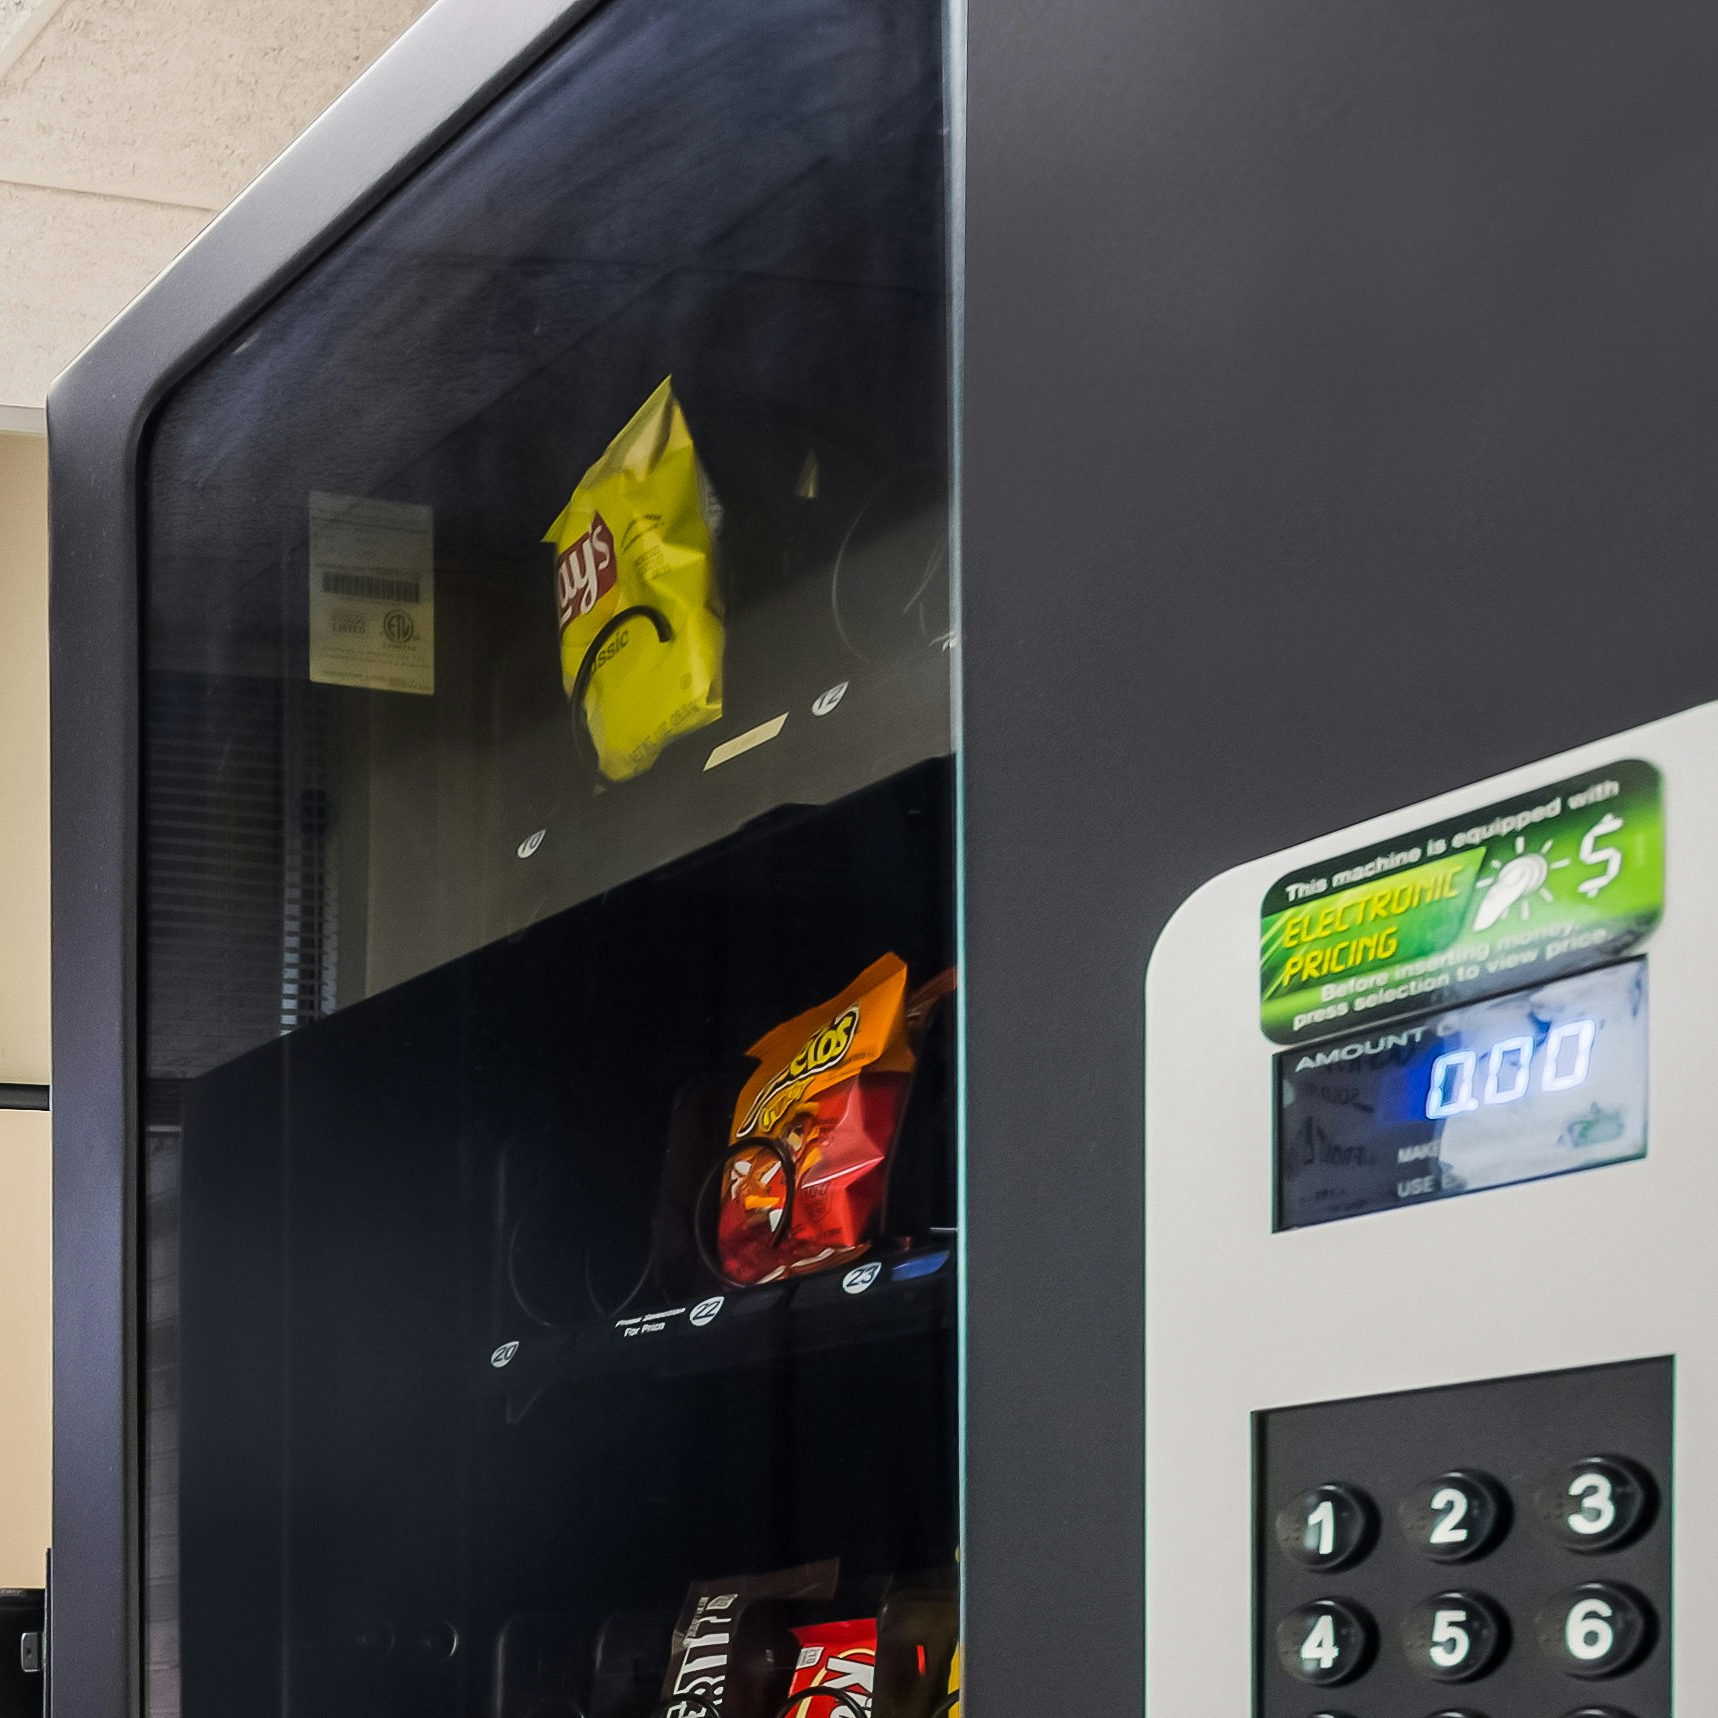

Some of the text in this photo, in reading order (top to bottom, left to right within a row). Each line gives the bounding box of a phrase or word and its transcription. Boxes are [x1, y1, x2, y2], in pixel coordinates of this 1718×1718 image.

[557, 523, 611, 621] ay's
[1286, 780, 1619, 902] This machine is equipped with
[1283, 864, 1464, 949] ELECTRONIC
[1283, 926, 1398, 987] PRICING
[1320, 971, 1389, 1003] Before
[1395, 942, 1491, 981] inserting
[1293, 1003, 1349, 1031] press
[1353, 975, 1450, 1010] selection
[1456, 963, 1481, 983] to
[1486, 949, 1538, 974] view
[1295, 1026, 1429, 1073] AMOUNT
[1426, 1019, 1596, 1120] 0.00
[1397, 1175, 1437, 1198] USE
[1307, 1501, 1334, 1555] 1
[1430, 1488, 1468, 1544] 2
[1567, 1472, 1615, 1534] 3
[1300, 1614, 1338, 1668] 4
[1430, 1610, 1469, 1666] 5
[1567, 1598, 1614, 1660] 6
